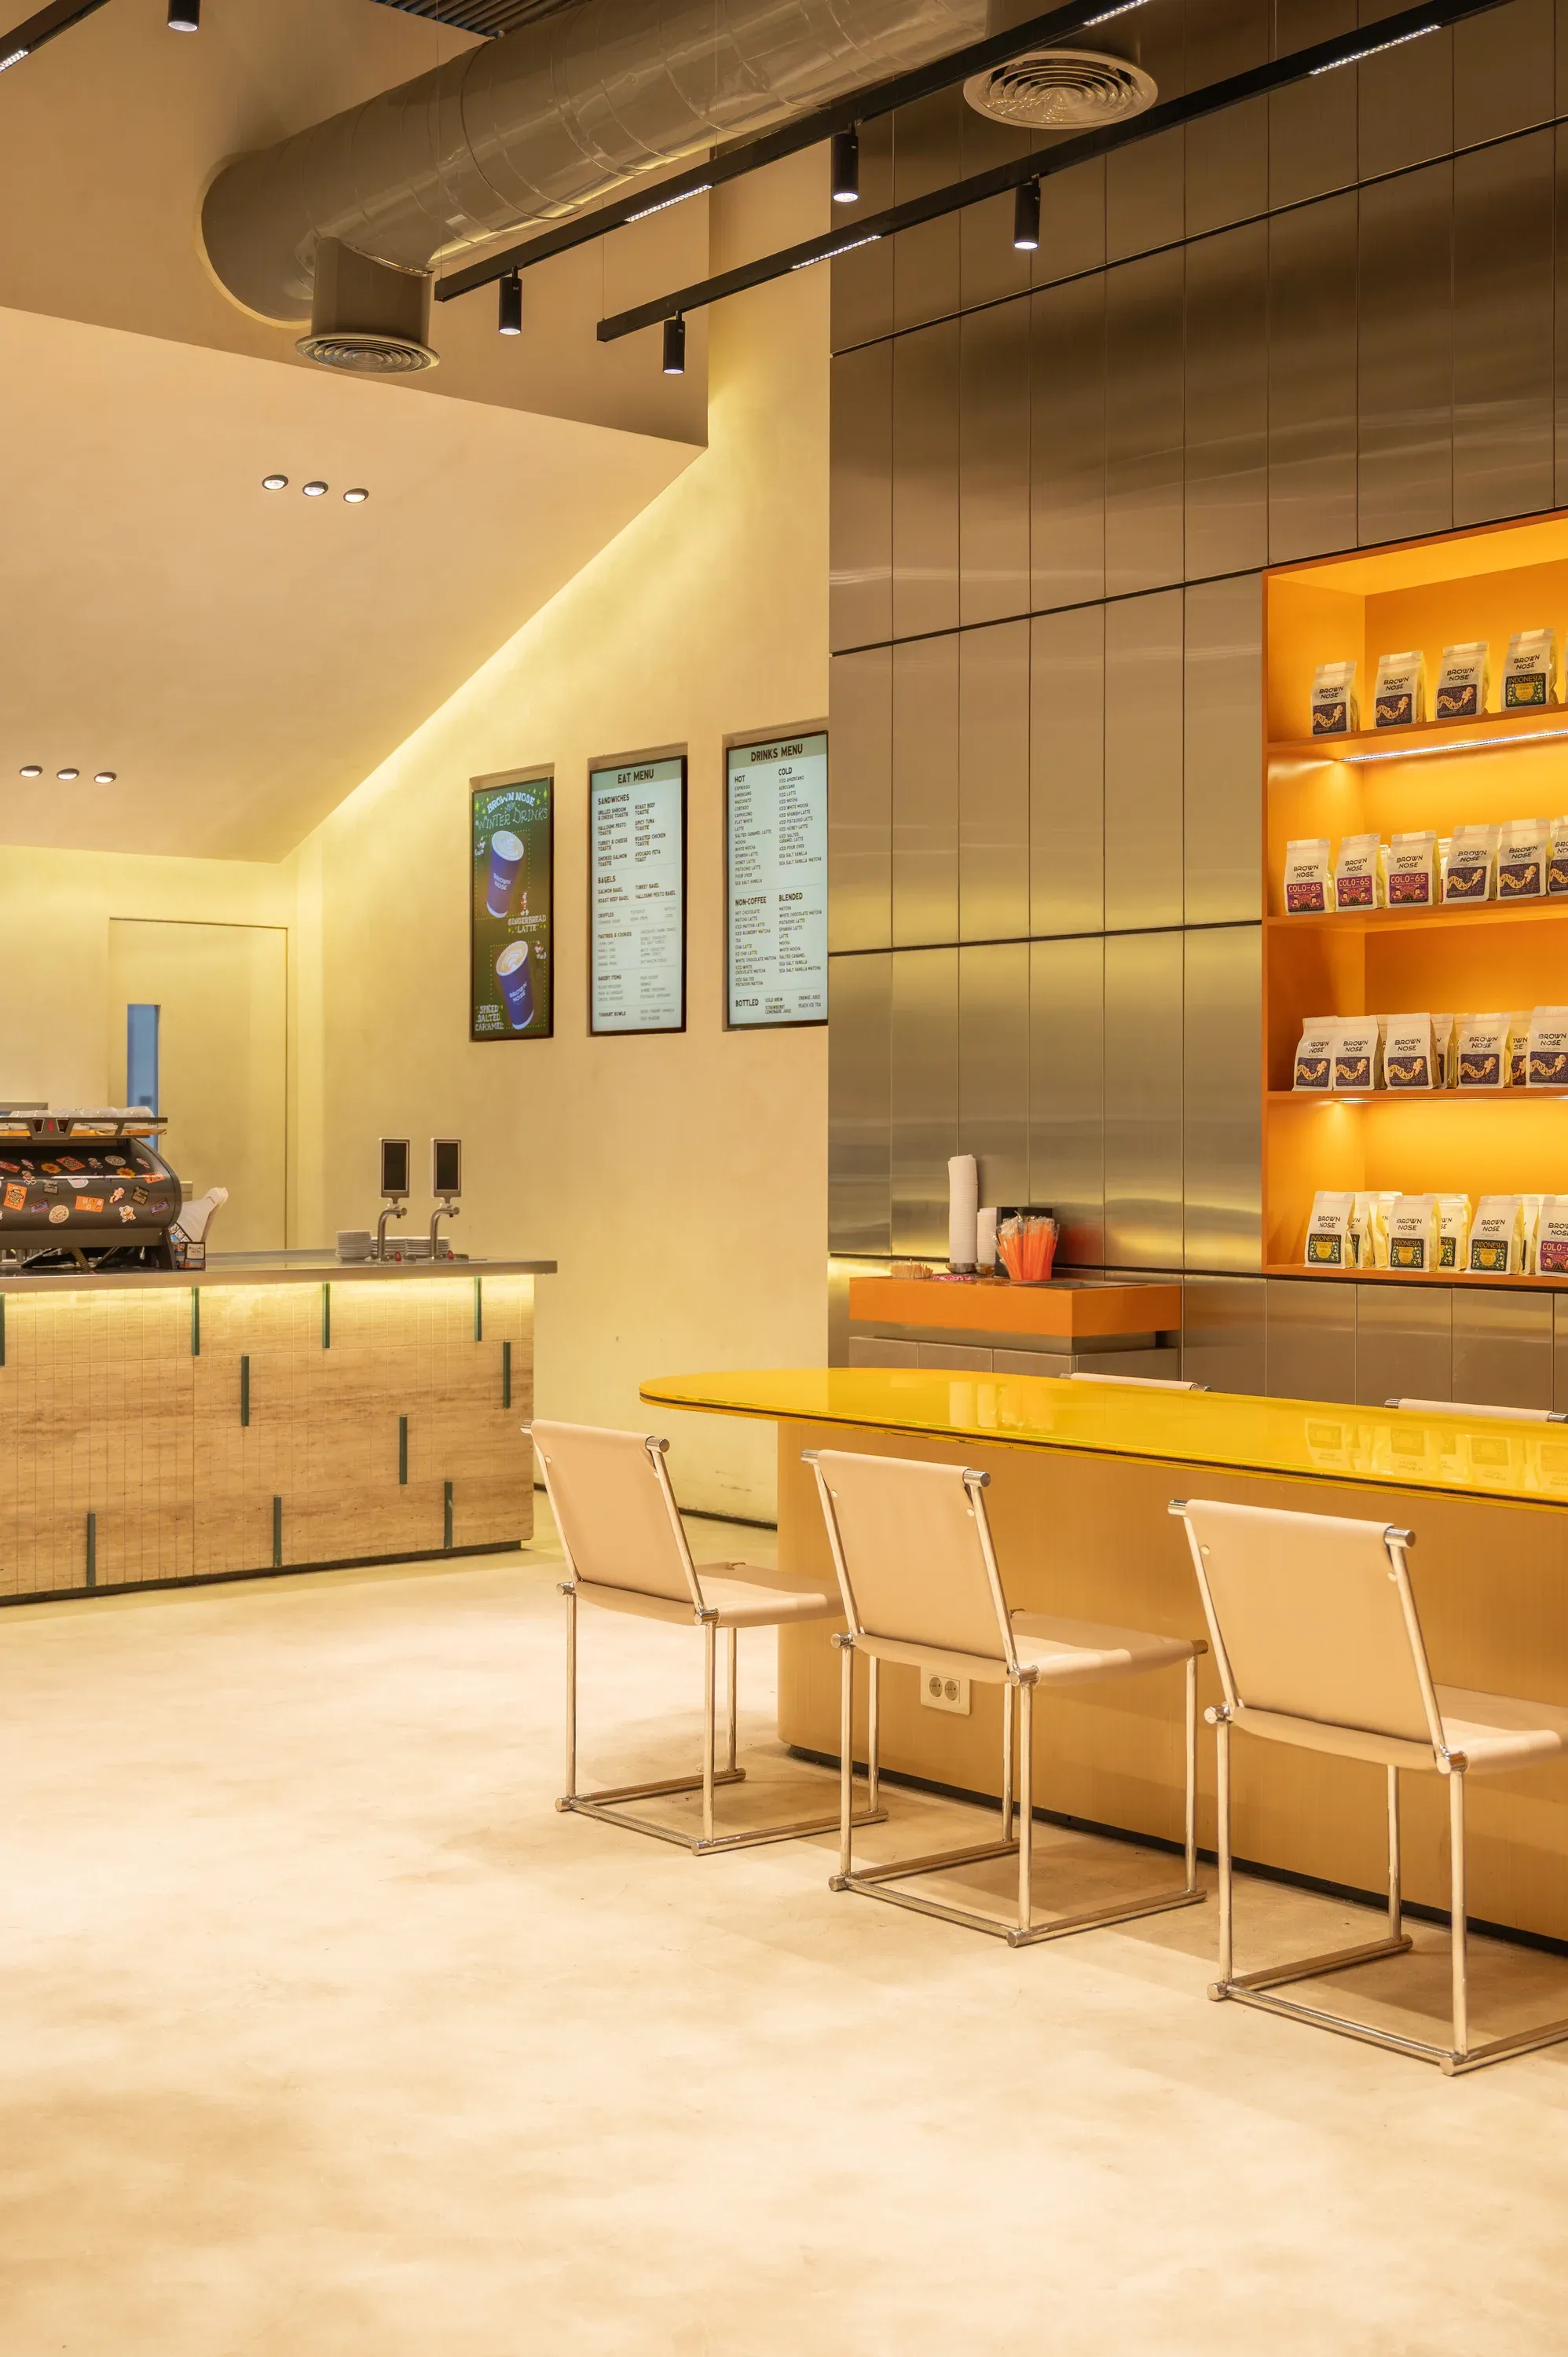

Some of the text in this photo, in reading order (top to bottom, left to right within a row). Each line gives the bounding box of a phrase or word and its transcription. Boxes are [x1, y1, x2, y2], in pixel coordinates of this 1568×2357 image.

[1514, 654, 1540, 663] BROWN
[1384, 676, 1409, 685] BROWN
[1508, 676, 1543, 684] INDONESIA
[751, 744, 803, 762] DRINKS MENU
[618, 769, 654, 783] EAT MENU
[487, 793, 535, 814] BROWN NOSE
[598, 794, 629, 805] SANDWICHES
[475, 808, 548, 830] WINTER DRINKS
[493, 873, 511, 885] BROWN
[599, 875, 616, 884] BAGELS
[1391, 874, 1426, 883] COLO-65
[495, 882, 507, 890] NOSE
[1288, 884, 1320, 893] COLO-65
[735, 896, 767, 906] NON-COFFEE
[779, 893, 803, 902] BLENDED
[508, 915, 546, 926] GINGERBREAD
[509, 981, 527, 998] BROWN
[513, 992, 526, 1003] NOSE
[479, 1005, 498, 1014] SPICED
[478, 1014, 500, 1022] SALTED
[475, 1022, 504, 1031] CARAMEL
